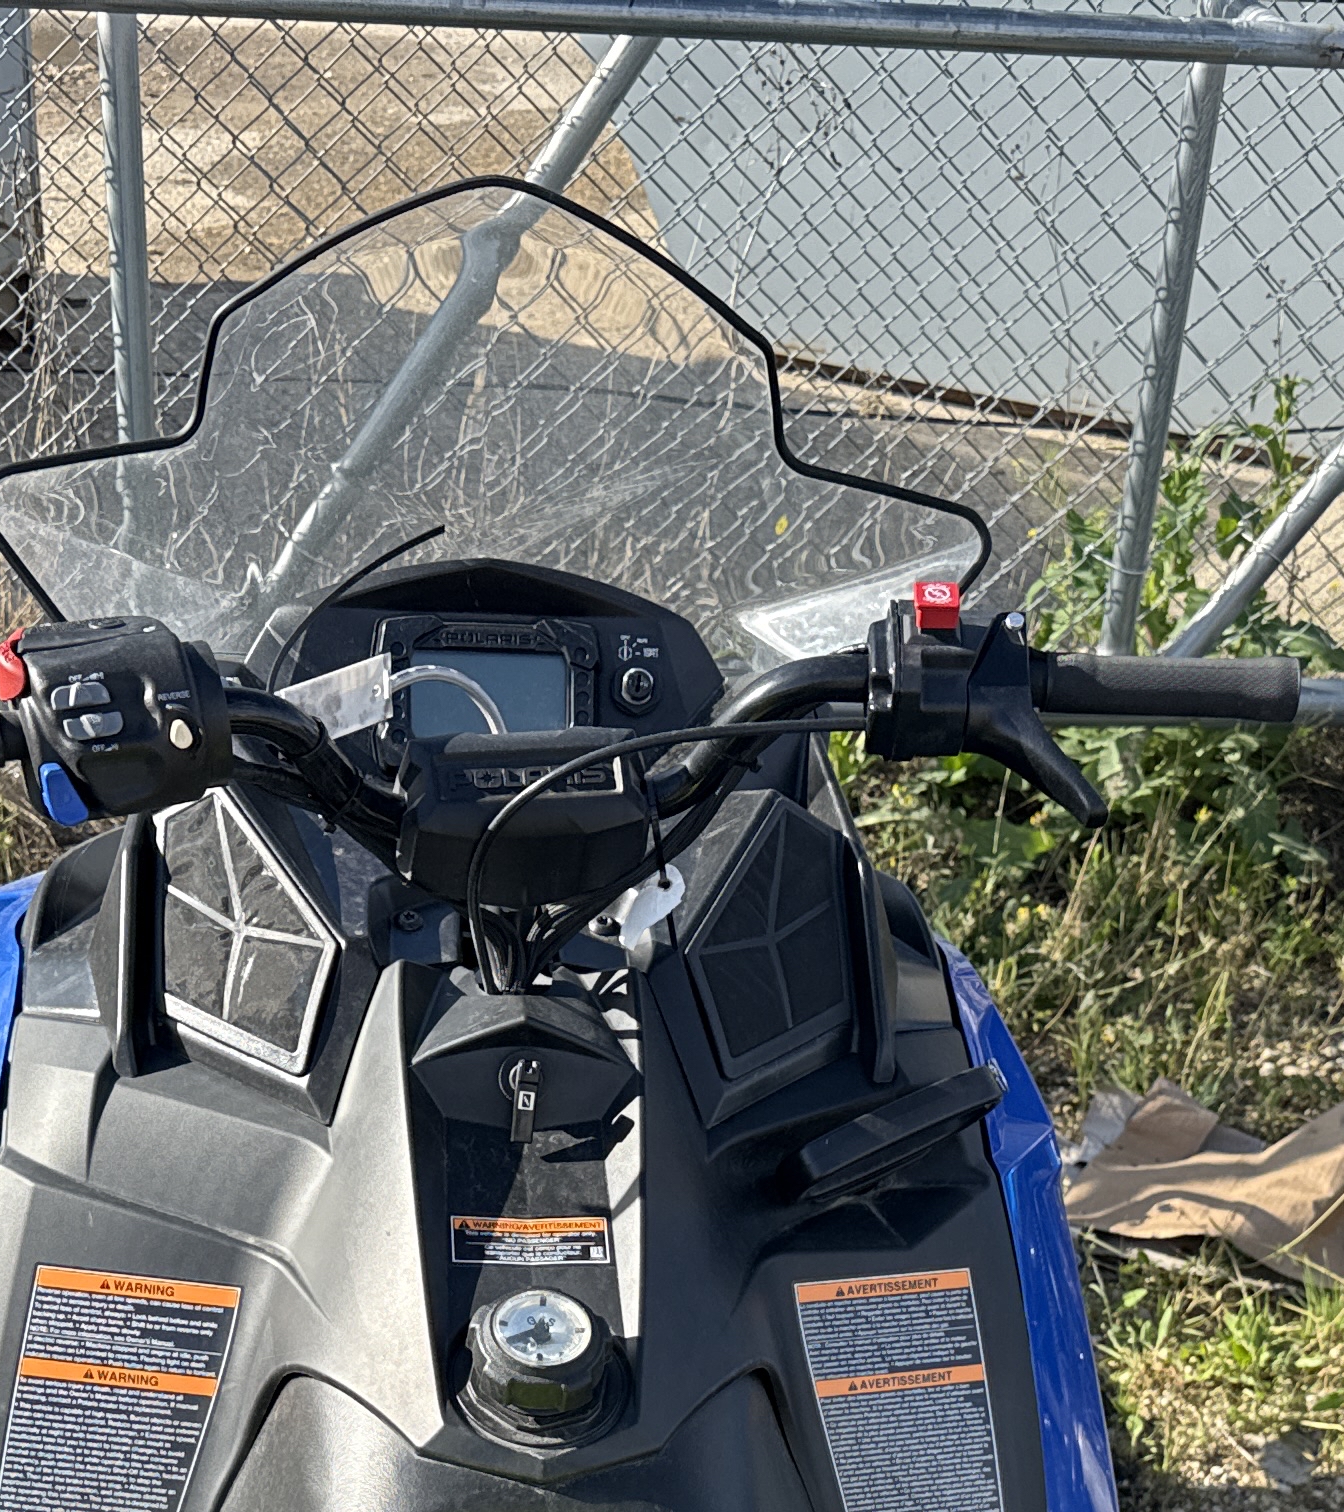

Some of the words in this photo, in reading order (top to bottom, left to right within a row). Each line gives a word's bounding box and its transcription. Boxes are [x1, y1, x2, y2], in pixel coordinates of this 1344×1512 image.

[446, 632, 533, 645] POLARIS
[158, 690, 191, 701] REVERSE
[453, 766, 608, 791] POLAIS
[113, 1279, 175, 1298] WARNING
[846, 1277, 939, 1296] AVERTISSEMENT
[97, 1369, 159, 1388] WARNING
[860, 1370, 953, 1390] AVERTISSEMENT
